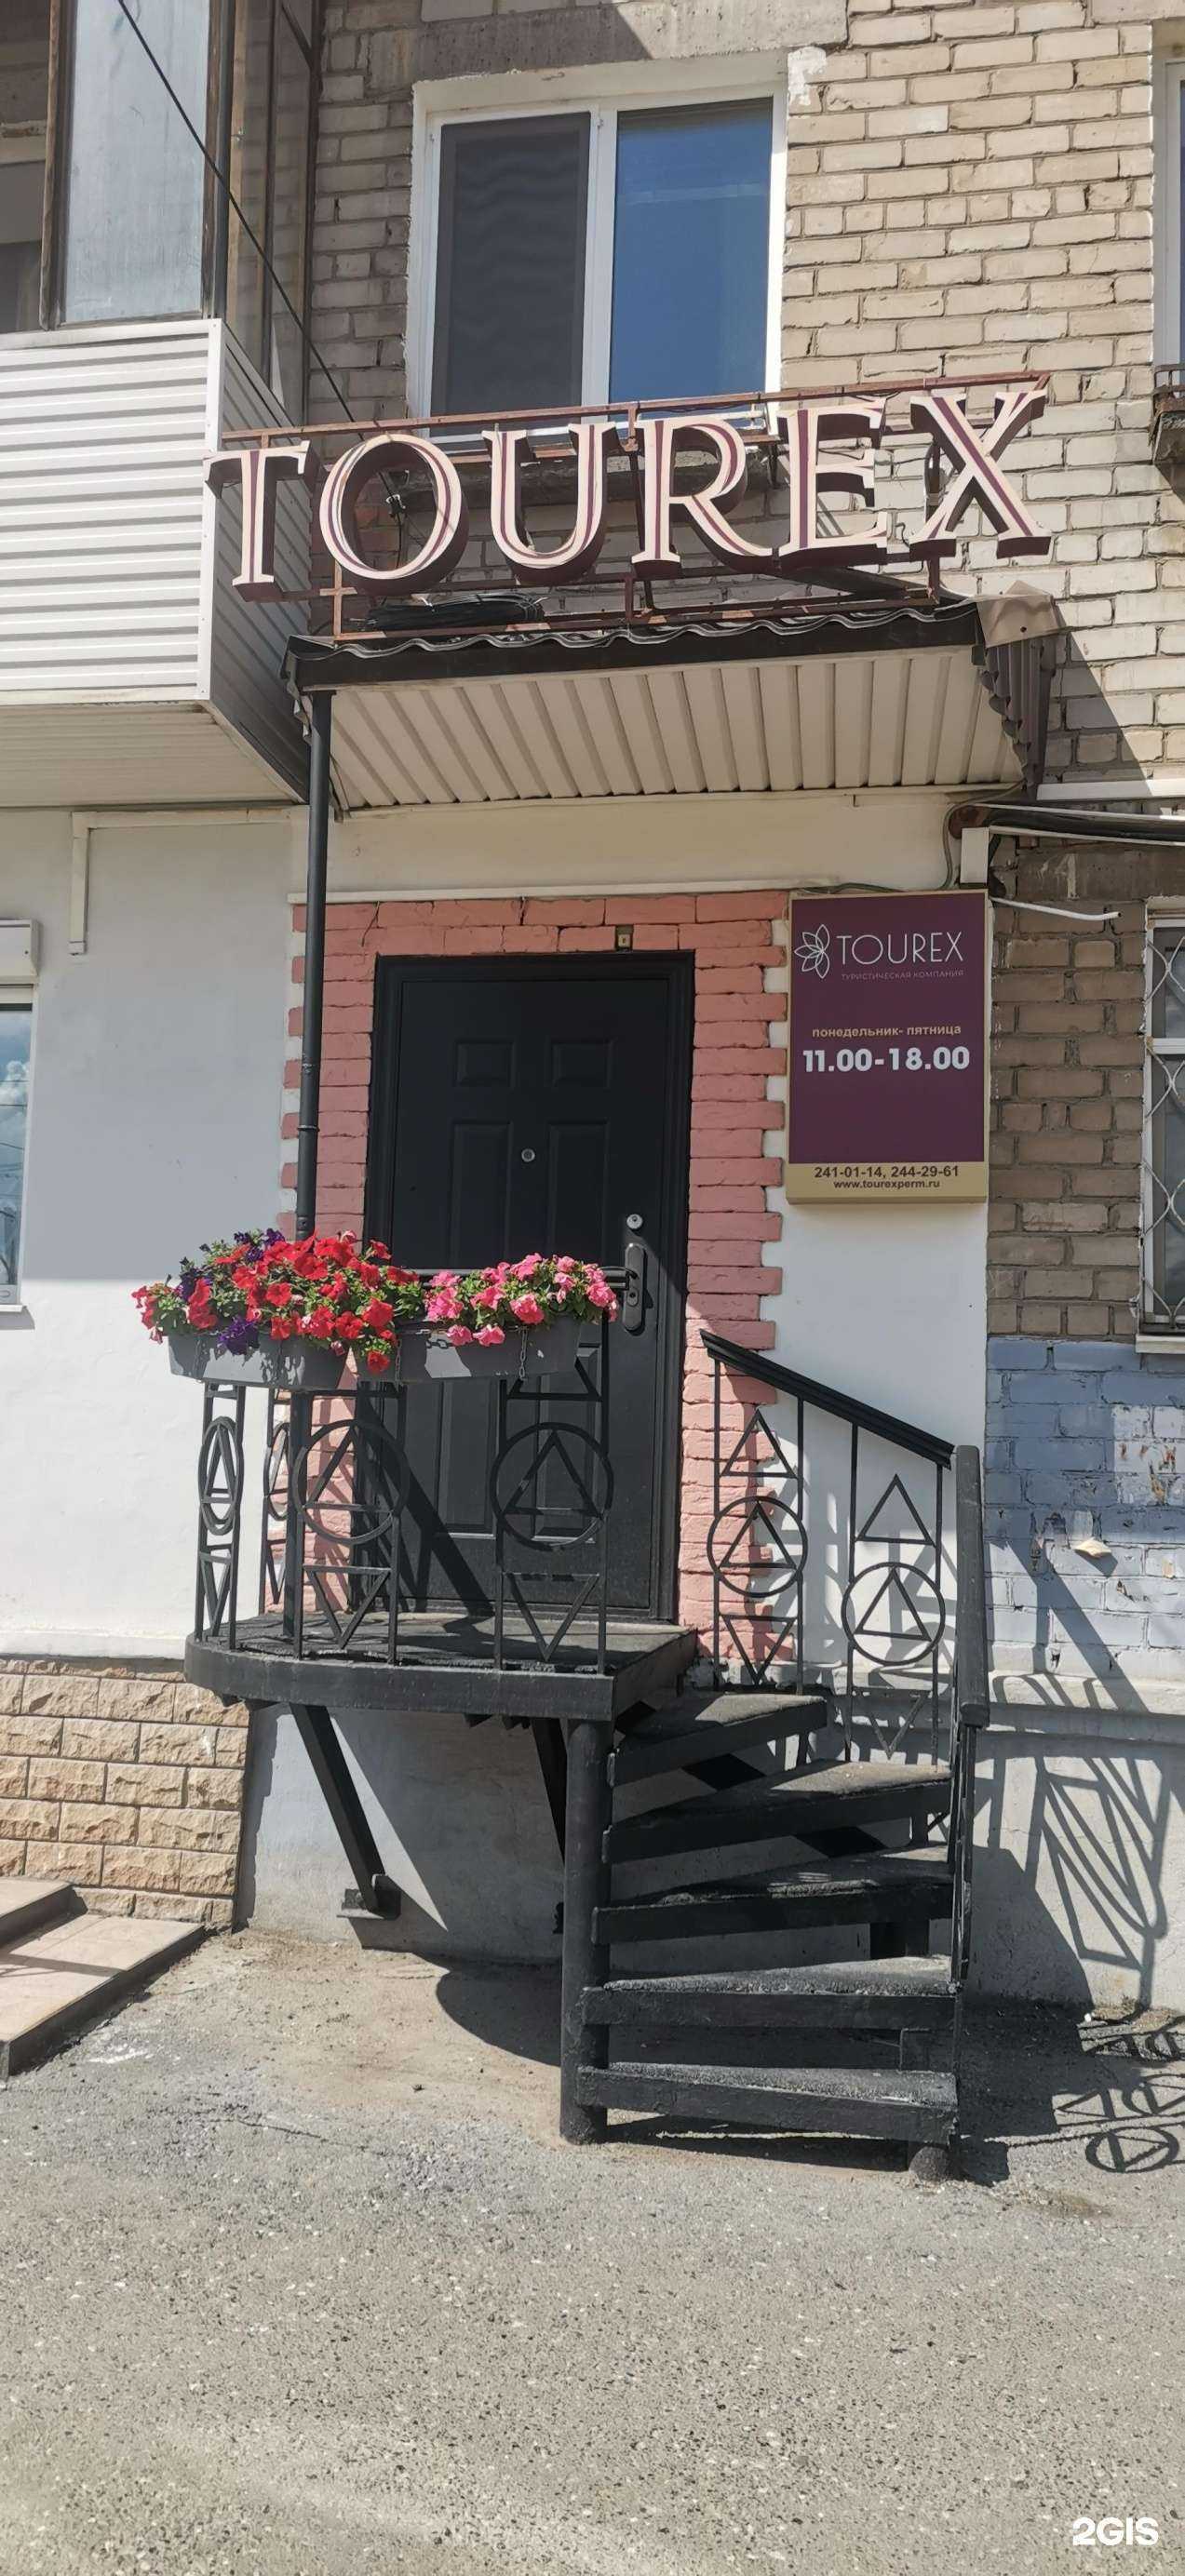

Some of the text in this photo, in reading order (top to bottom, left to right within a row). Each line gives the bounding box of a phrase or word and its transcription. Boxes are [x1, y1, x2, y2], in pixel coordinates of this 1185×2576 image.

[204, 390, 1053, 601] TOUREX
[836, 931, 963, 965] TOUREX
[812, 1024, 961, 1038] понедельник- пятница
[802, 1046, 970, 1072] 11.00-18.00
[815, 1166, 959, 1178] 241-01-14, 244-29-61
[834, 1179, 940, 1189] www.tourexperm.ru
